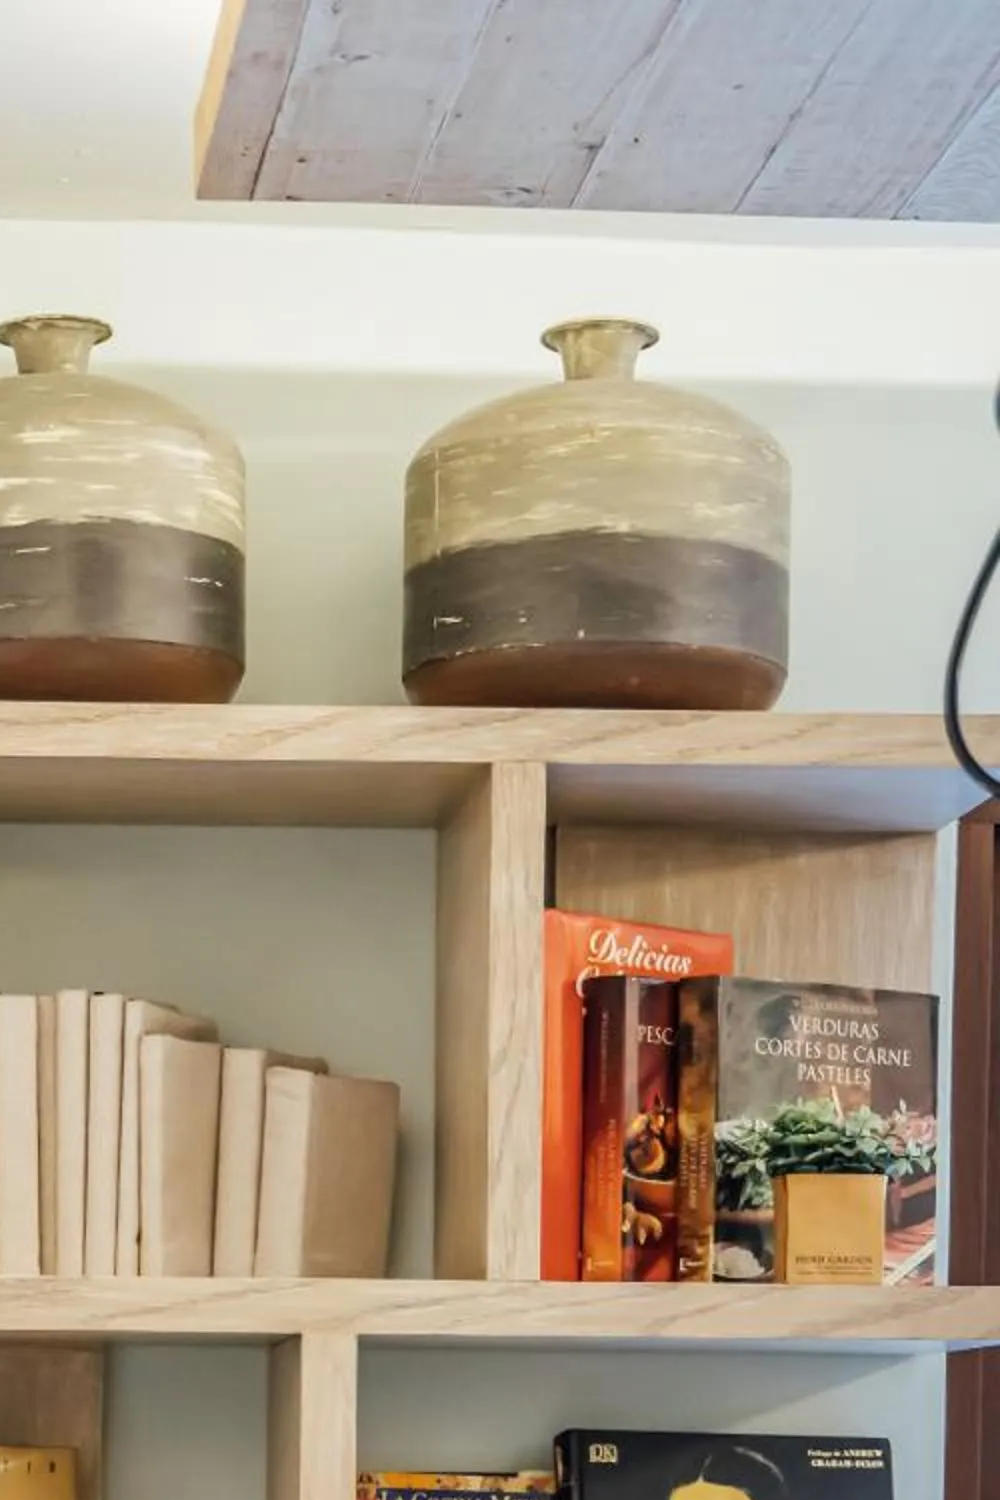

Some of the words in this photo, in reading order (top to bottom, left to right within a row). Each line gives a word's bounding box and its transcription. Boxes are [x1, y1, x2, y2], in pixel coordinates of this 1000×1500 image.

[587, 928, 692, 974] Delicias
[789, 1014, 879, 1040] VERDURAS
[754, 1037, 822, 1059] CORTES
[827, 1043, 849, 1062] DE
[853, 1045, 912, 1067] CARNE
[798, 1063, 871, 1085] PASTELES
